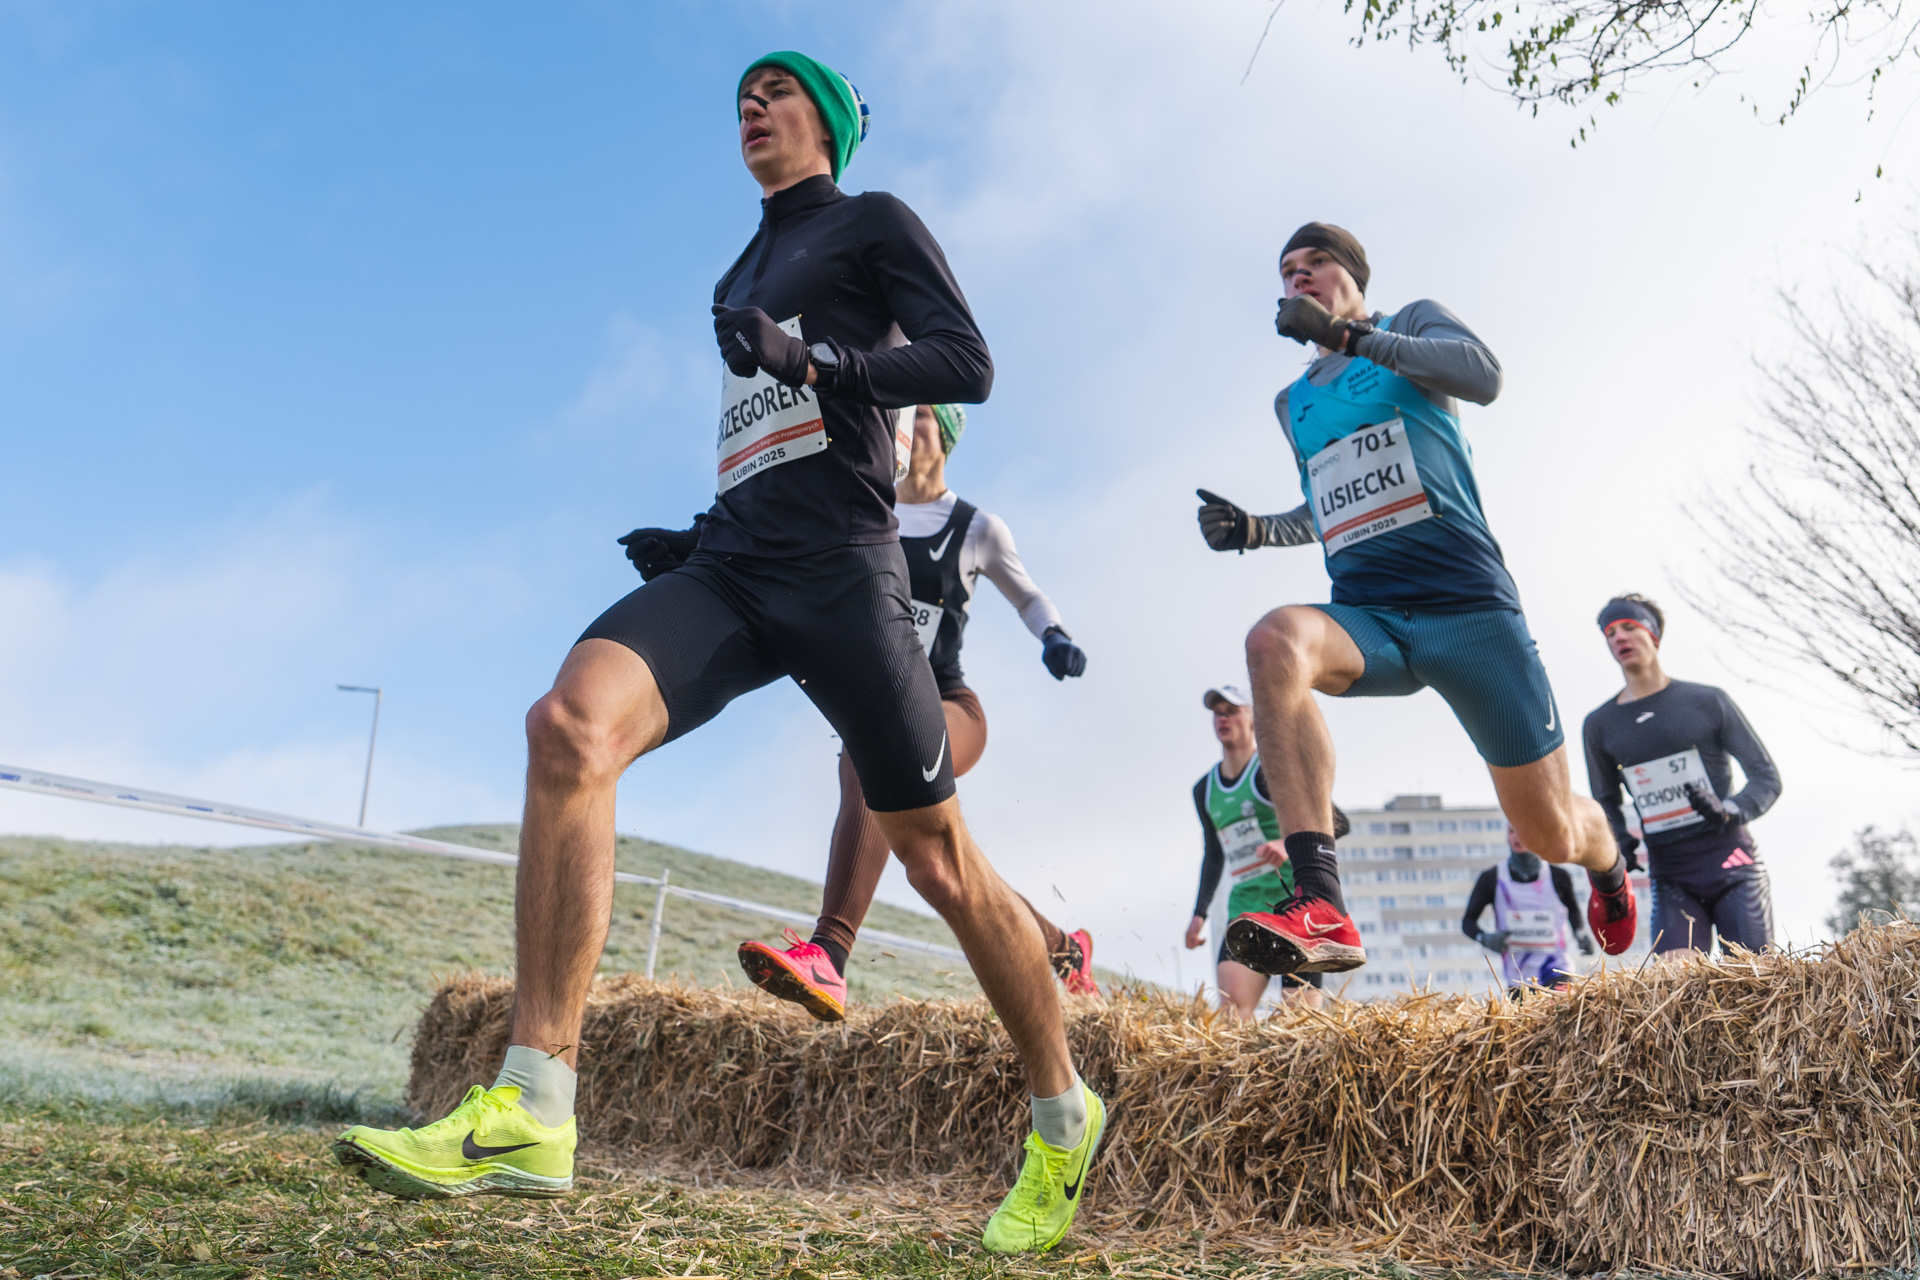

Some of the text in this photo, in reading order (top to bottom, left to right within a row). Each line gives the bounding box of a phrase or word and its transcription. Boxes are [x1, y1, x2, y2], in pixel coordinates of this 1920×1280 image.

[717, 383, 810, 451] RZEGOREK
[1352, 428, 1396, 458] 701
[732, 447, 786, 482] LUBIN 2025
[1320, 463, 1405, 517] LISIECKI
[1343, 517, 1397, 543] LUBIN 2025
[1669, 757, 1687, 774] 57
